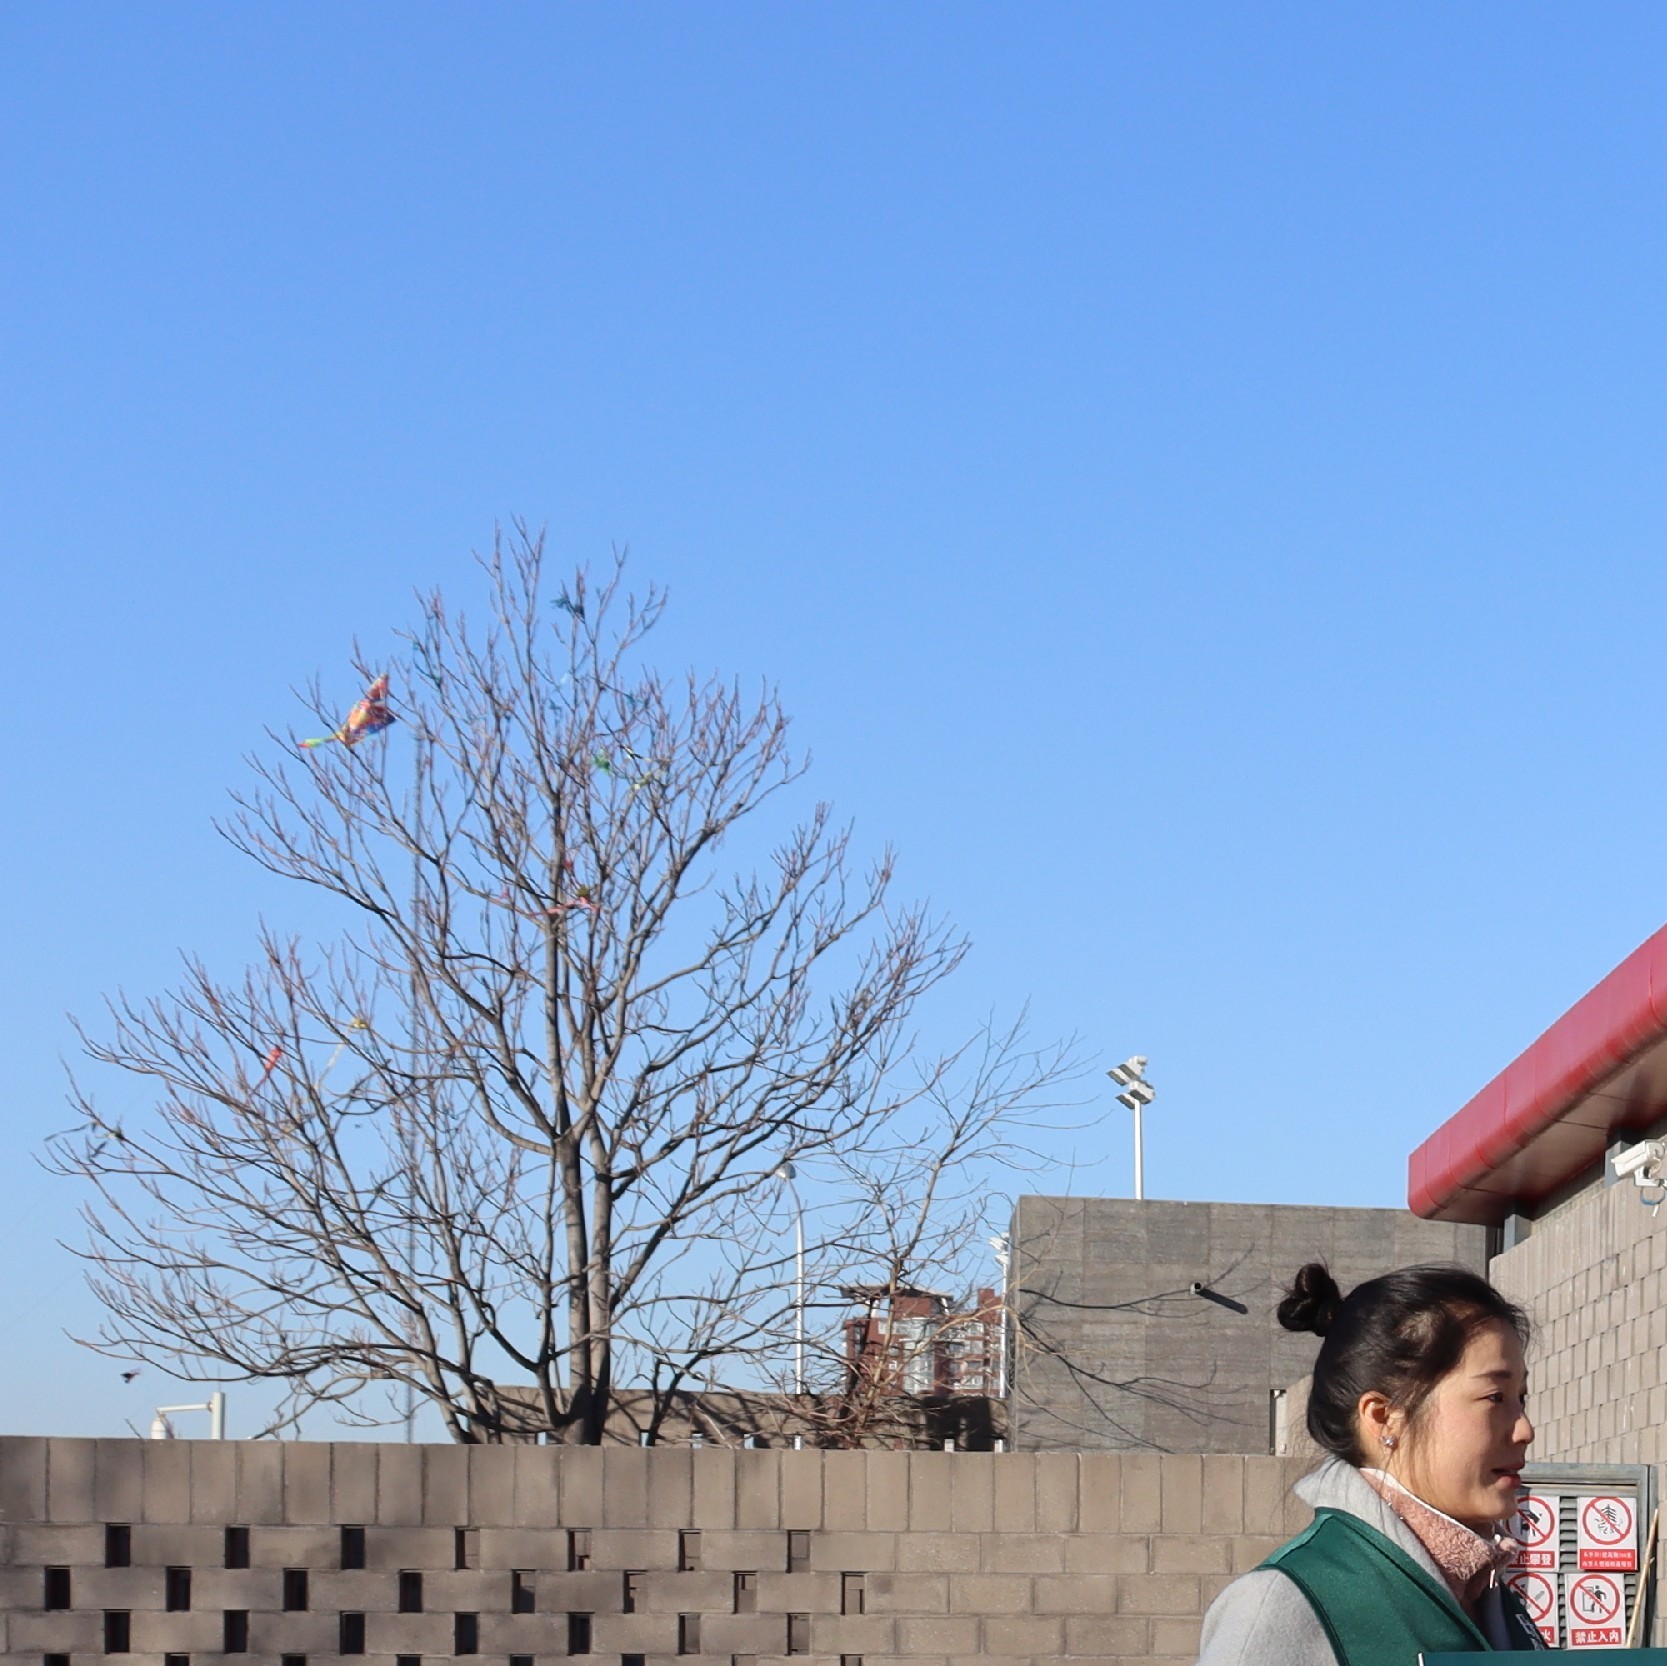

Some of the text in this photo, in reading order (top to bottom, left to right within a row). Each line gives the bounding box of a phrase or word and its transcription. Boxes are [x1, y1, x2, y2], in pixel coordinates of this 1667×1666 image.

[1516, 1553, 1551, 1566] 止攀登
[1575, 1630, 1619, 1643] 禁止入内
